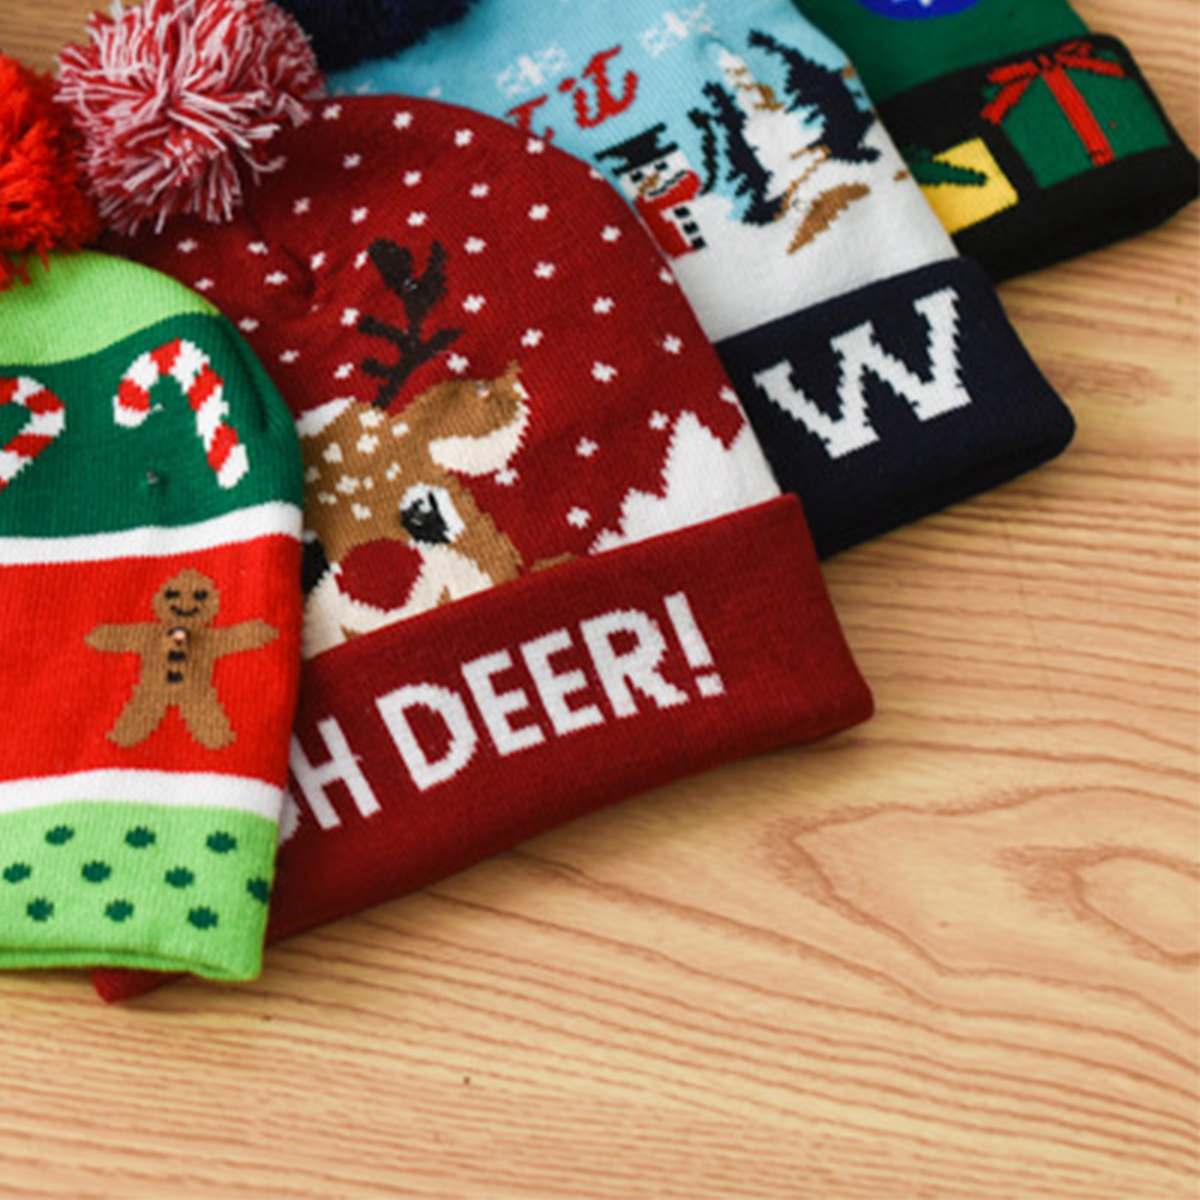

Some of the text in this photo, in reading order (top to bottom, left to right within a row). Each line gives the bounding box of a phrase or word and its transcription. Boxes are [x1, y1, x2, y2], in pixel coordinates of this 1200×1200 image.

[752, 286, 973, 460] W
[277, 591, 725, 846] H DEER!
